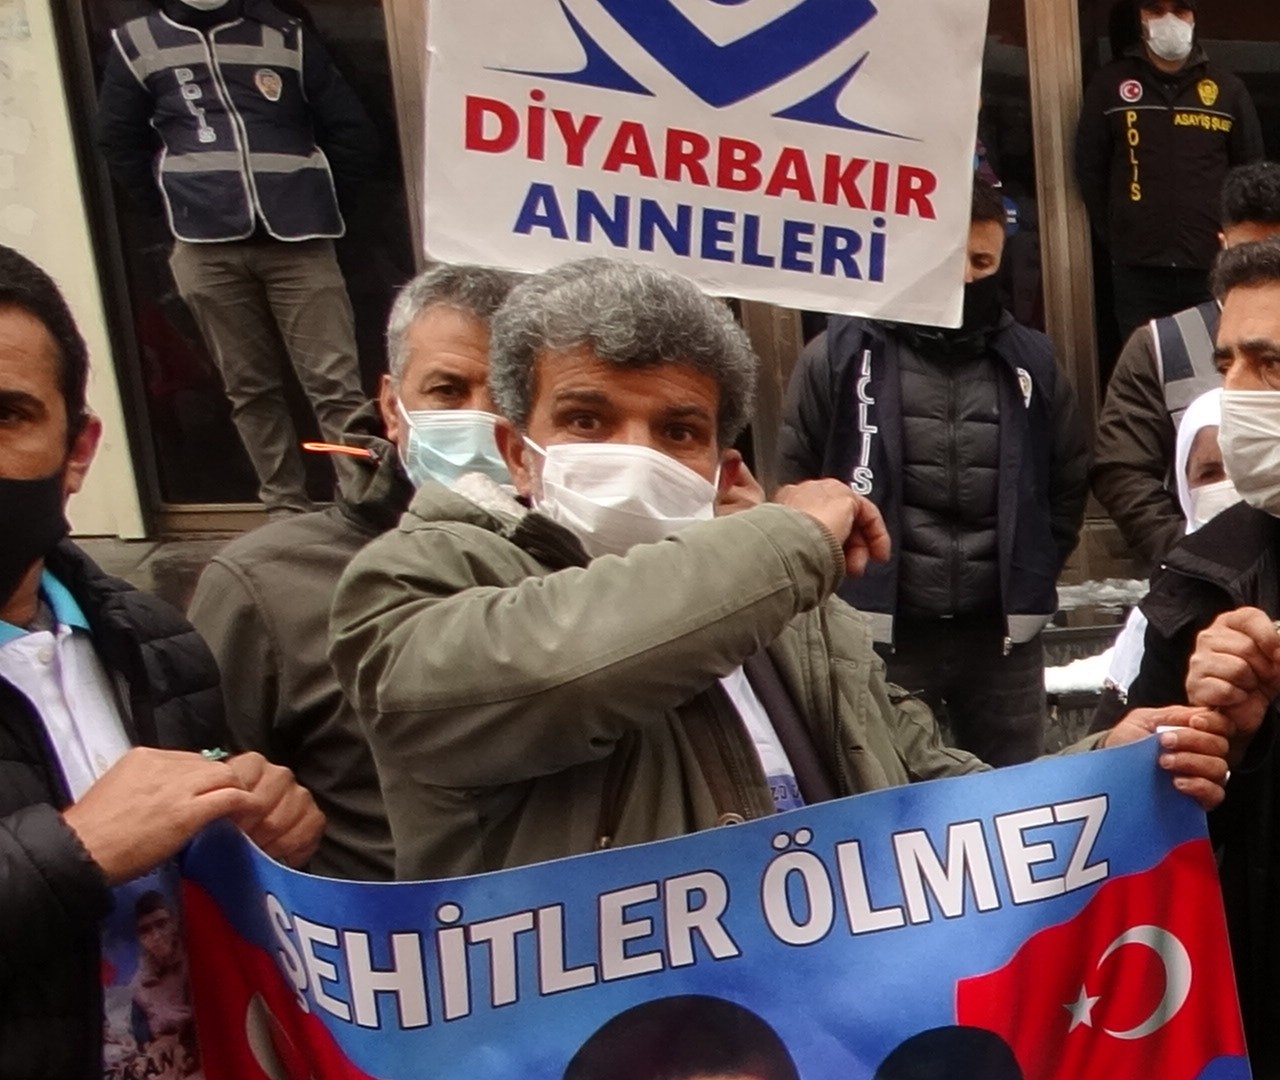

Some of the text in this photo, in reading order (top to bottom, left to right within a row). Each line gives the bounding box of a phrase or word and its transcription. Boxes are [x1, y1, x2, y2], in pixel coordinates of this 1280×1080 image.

[464, 90, 938, 220] DİYARBAKIR
[513, 183, 887, 283] ANNELERİ
[266, 795, 1110, 1031] ŞEHİTLER ÖLMEZ
